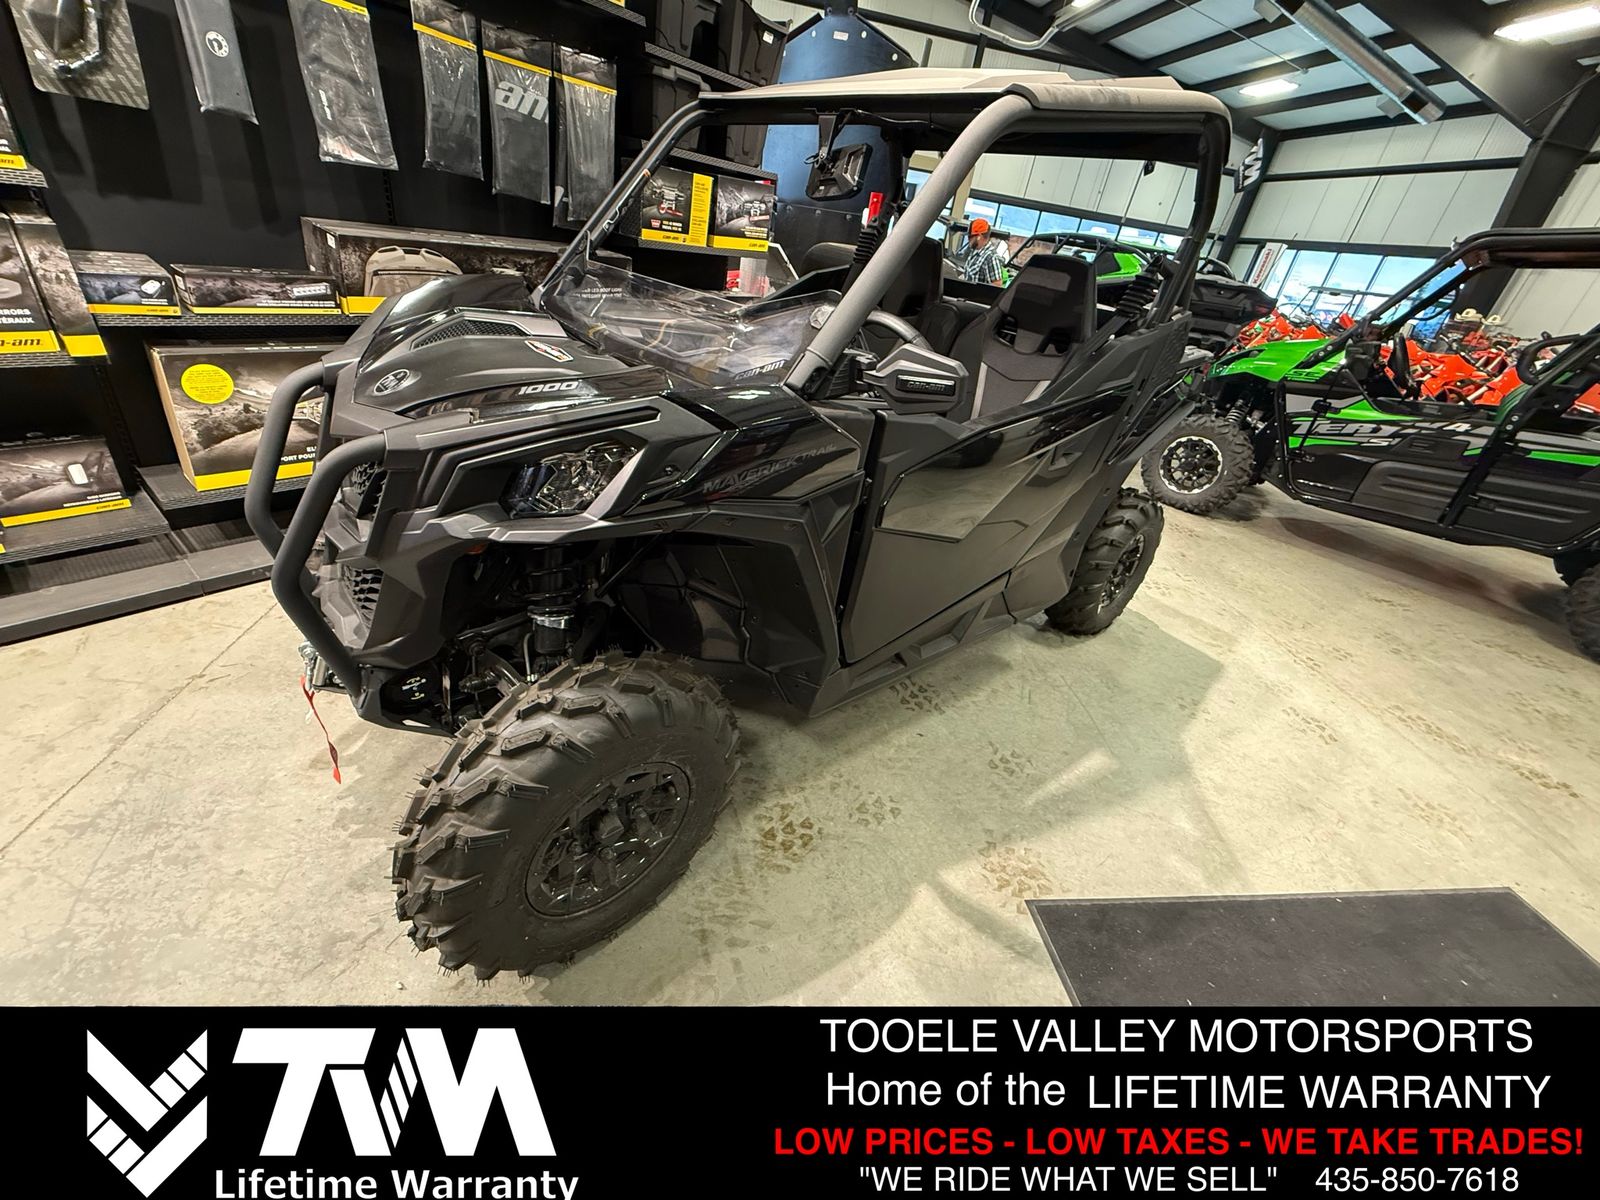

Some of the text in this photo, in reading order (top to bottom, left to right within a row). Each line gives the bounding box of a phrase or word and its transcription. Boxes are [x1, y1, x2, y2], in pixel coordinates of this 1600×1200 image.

[1253, 248, 1272, 284] Kawasaki
[735, 359, 785, 381] can-am
[518, 381, 579, 395] 1000
[906, 380, 946, 392] can-am
[702, 454, 799, 493] MAVERICK
